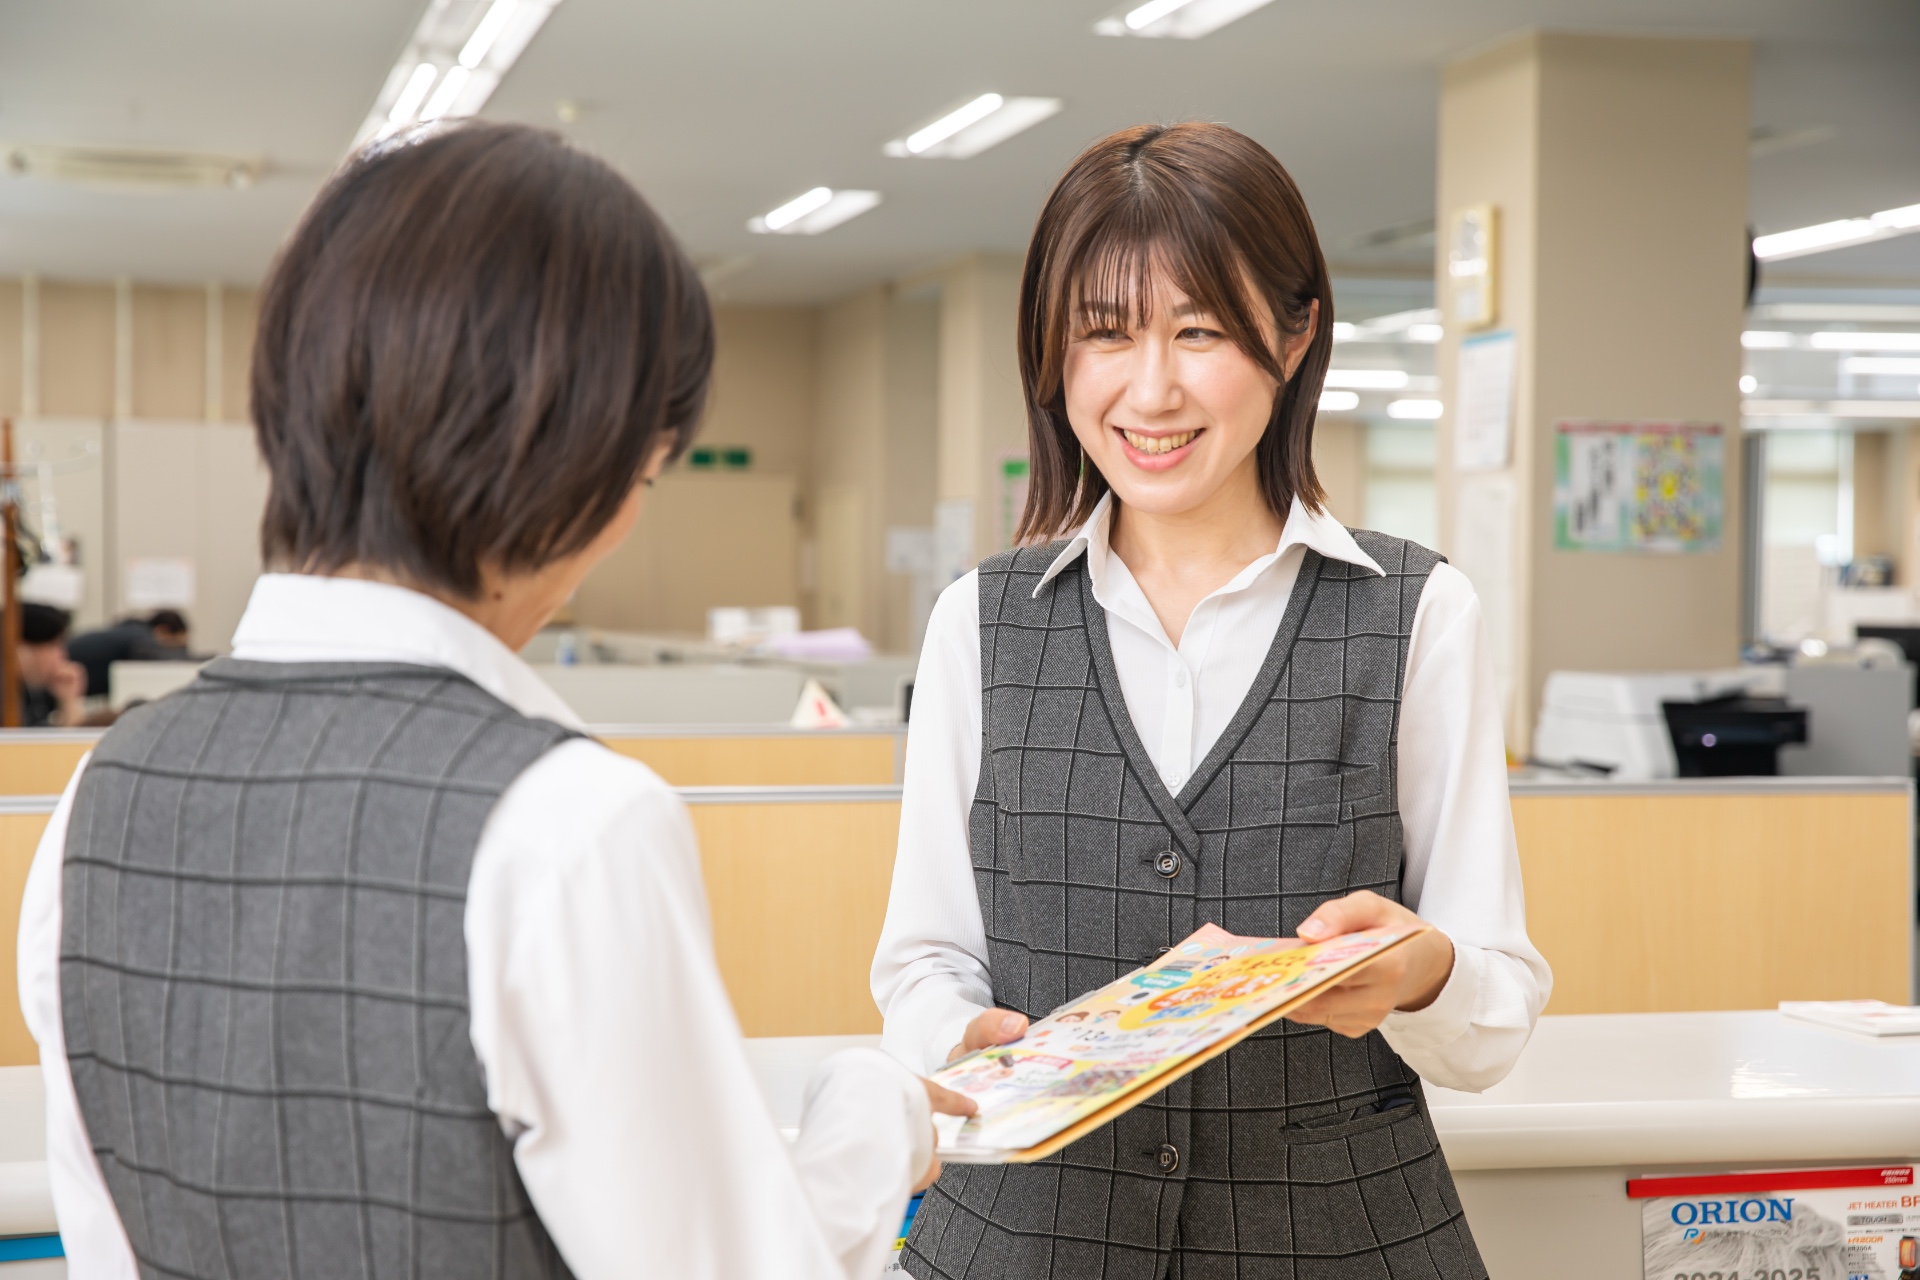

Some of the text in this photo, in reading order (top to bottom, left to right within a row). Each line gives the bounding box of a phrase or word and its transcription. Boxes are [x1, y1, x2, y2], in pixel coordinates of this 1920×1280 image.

[1671, 1198, 1795, 1226] ORION
[1847, 1201, 1862, 1210] JET
[1865, 1200, 1897, 1209] HEATER
